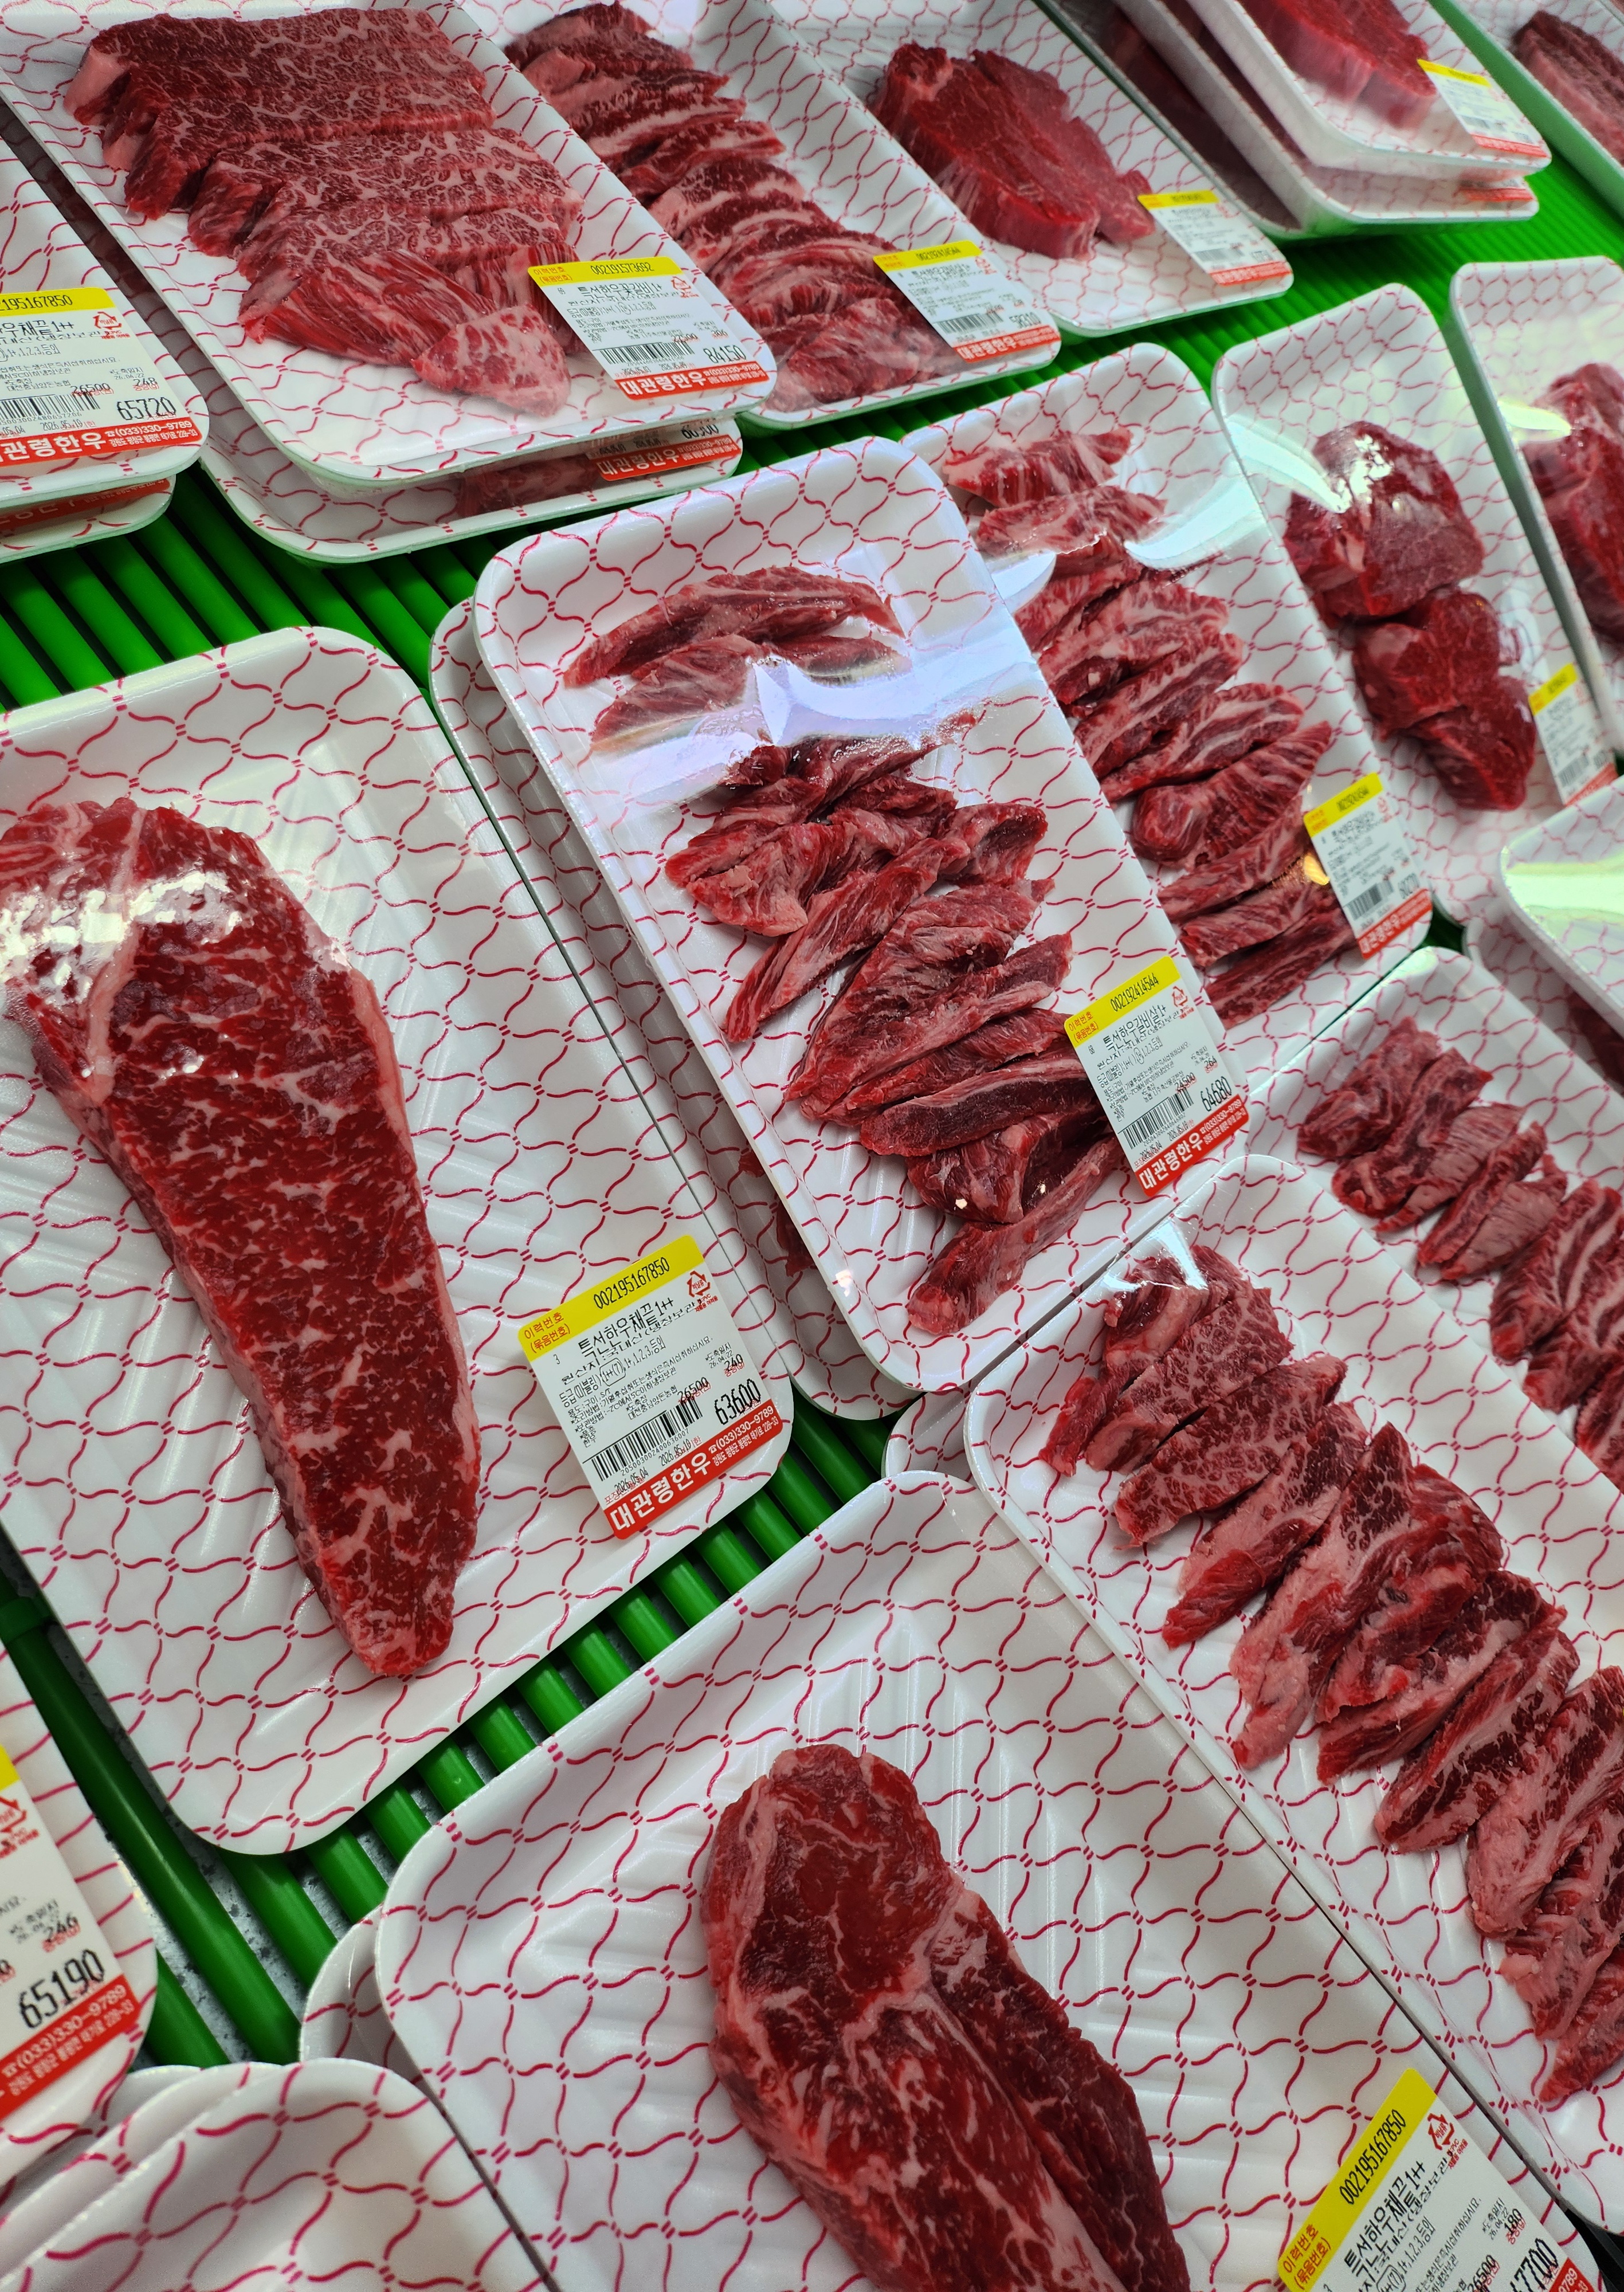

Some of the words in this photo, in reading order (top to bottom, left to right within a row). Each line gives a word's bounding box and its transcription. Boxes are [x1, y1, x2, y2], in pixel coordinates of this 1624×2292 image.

[588, 261, 655, 276] 002191573692
[701, 344, 748, 364] 84150
[70, 383, 112, 394] 26500
[132, 378, 159, 386] 248
[618, 370, 710, 396] 대관령한우
[113, 397, 180, 421] 65720
[0, 431, 111, 461] 관령한우
[112, 421, 194, 437] (033)330-9789
[1109, 971, 1159, 1013] 002192414544
[1068, 1010, 1093, 1032] 이력번호
[1174, 1071, 1196, 1092] 24500
[1203, 1054, 1217, 1069] 264
[1198, 1074, 1233, 1112] 64680
[1203, 1098, 1242, 1132] (033)330-9789
[1137, 1130, 1205, 1192] 대관령한우
[592, 1255, 671, 1311] 002195167850
[523, 1310, 564, 1341] 이력번호
[529, 1322, 571, 1354] (묶음번호)
[552, 1353, 561, 1365] 3
[676, 1375, 709, 1403] 26500
[723, 1352, 744, 1372] 240
[708, 1349, 734, 1369] 26.04.22
[711, 1376, 763, 1426] 63600
[715, 1403, 775, 1451] (033)330-9789
[613, 1465, 649, 1496] 2026.05.04
[657, 1437, 693, 1467] 2026.05.10
[620, 1427, 690, 1477] 205003002400636007
[711, 1450, 728, 1467] 강원도
[609, 1449, 714, 1534] 대관령한우
[12, 1944, 109, 2033] 65190
[15, 1981, 128, 2071] (033)330-9789
[1337, 2106, 1408, 2207] 002195167850
[1502, 2207, 1524, 2237] 180
[1281, 2221, 1320, 2276] 이력번호
[1292, 2234, 1332, 2292] (묶음번호)
